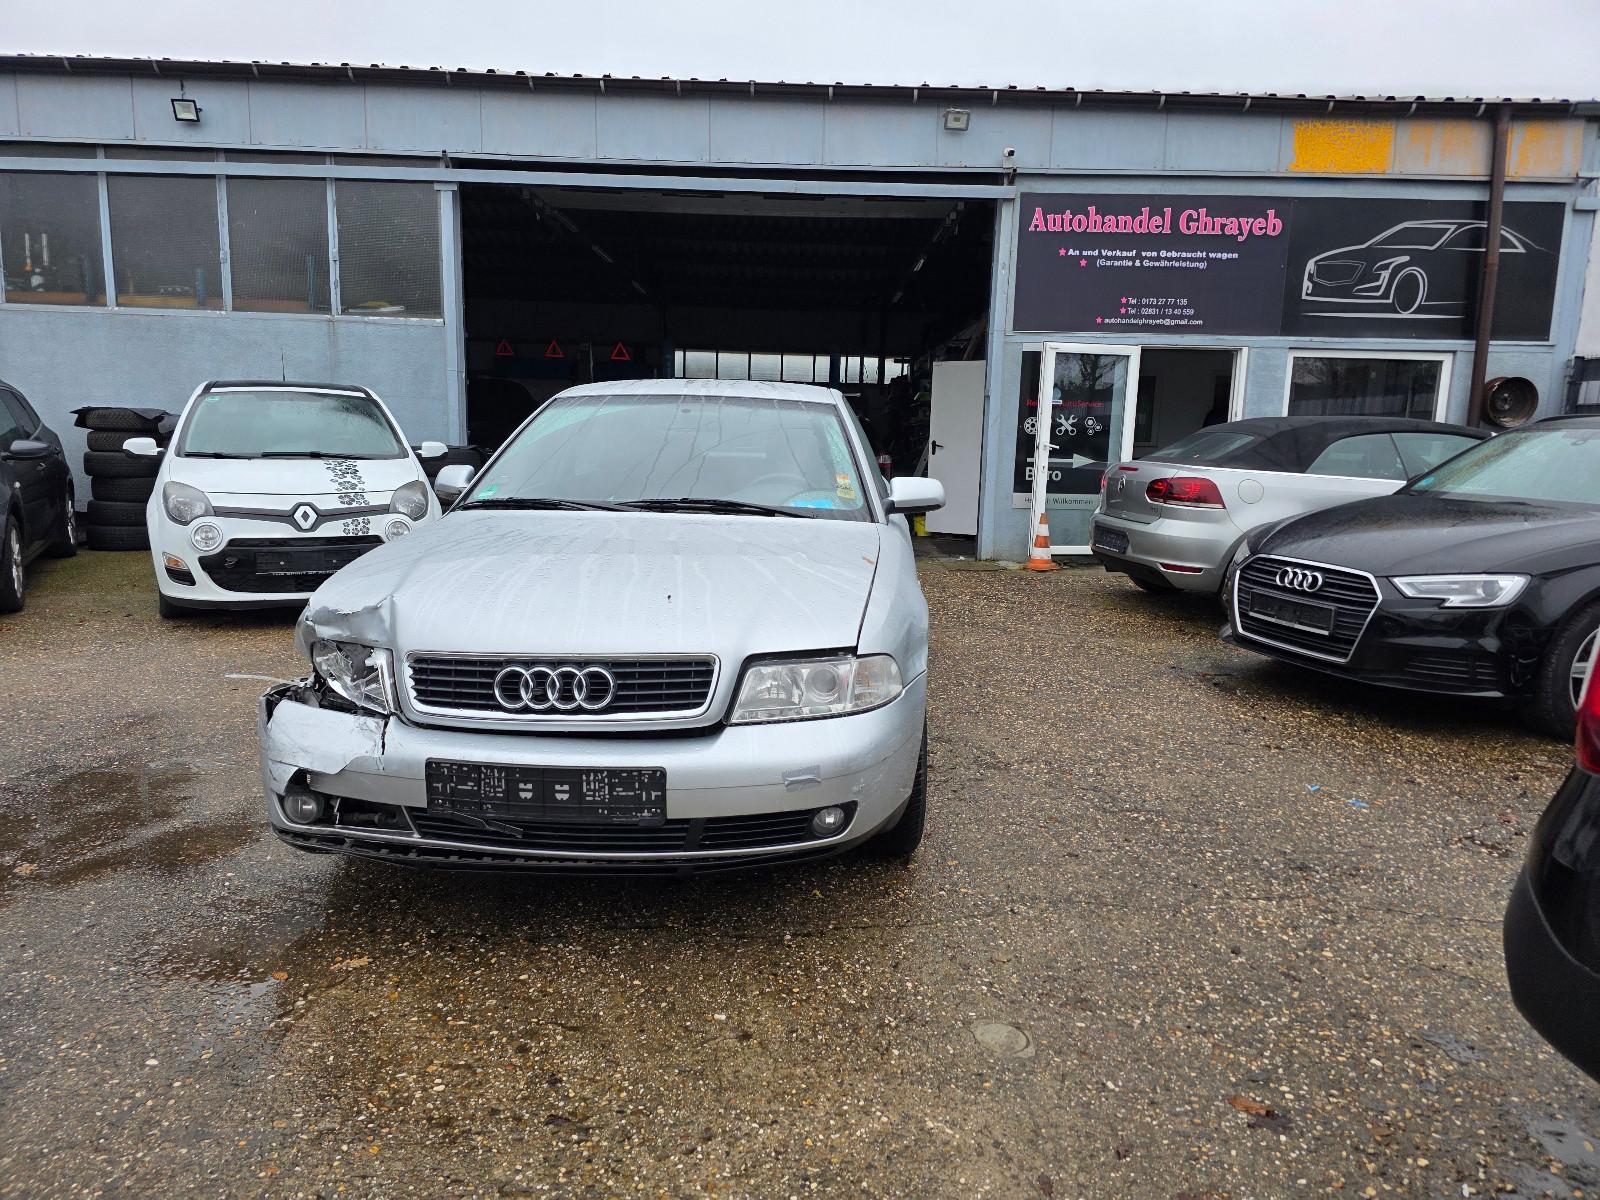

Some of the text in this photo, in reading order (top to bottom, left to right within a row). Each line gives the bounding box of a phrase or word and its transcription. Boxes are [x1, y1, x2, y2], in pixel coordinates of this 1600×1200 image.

[1028, 206, 1282, 241] Autohandel Ghrayeb
[1101, 249, 1136, 257] Verkauf
[1160, 250, 1206, 258] Gebraucht
[1209, 251, 1238, 259] wagen
[1096, 259, 1132, 267] (Garantie
[1026, 467, 1061, 481] Bro
